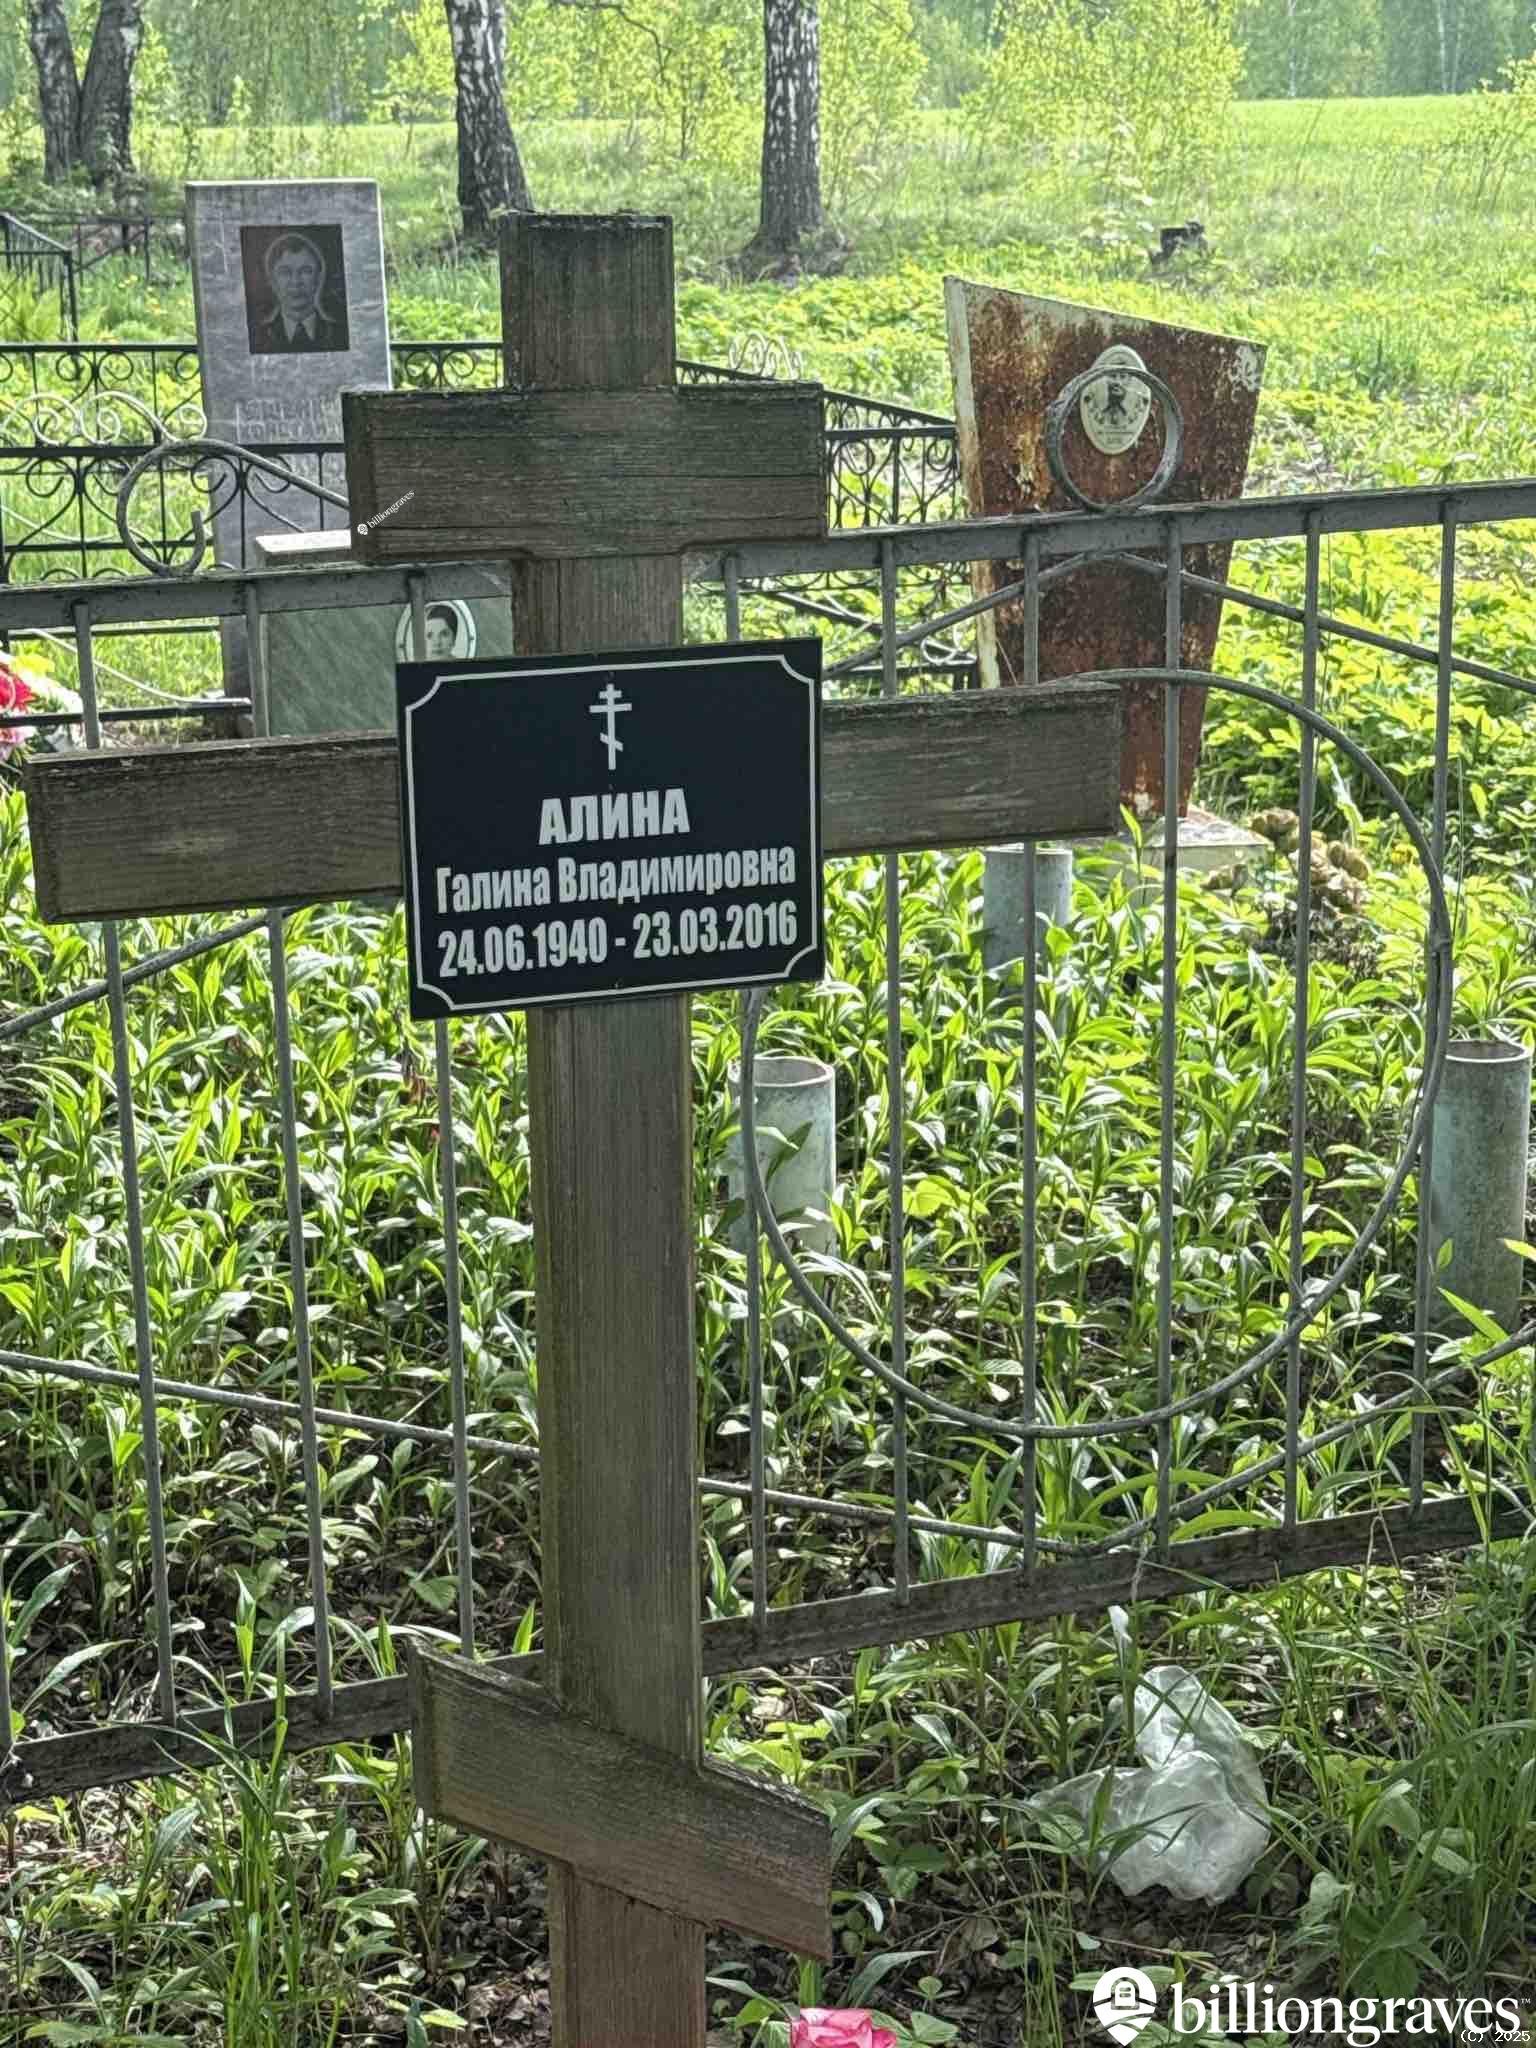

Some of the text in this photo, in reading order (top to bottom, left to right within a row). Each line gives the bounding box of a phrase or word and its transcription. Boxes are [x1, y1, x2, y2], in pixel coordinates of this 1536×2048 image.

[538, 788, 691, 846] АЛИНА
[436, 846, 797, 914] Галина Владимировна
[437, 916, 608, 978] 24.06.1940
[632, 900, 798, 959] 23.03.2016
